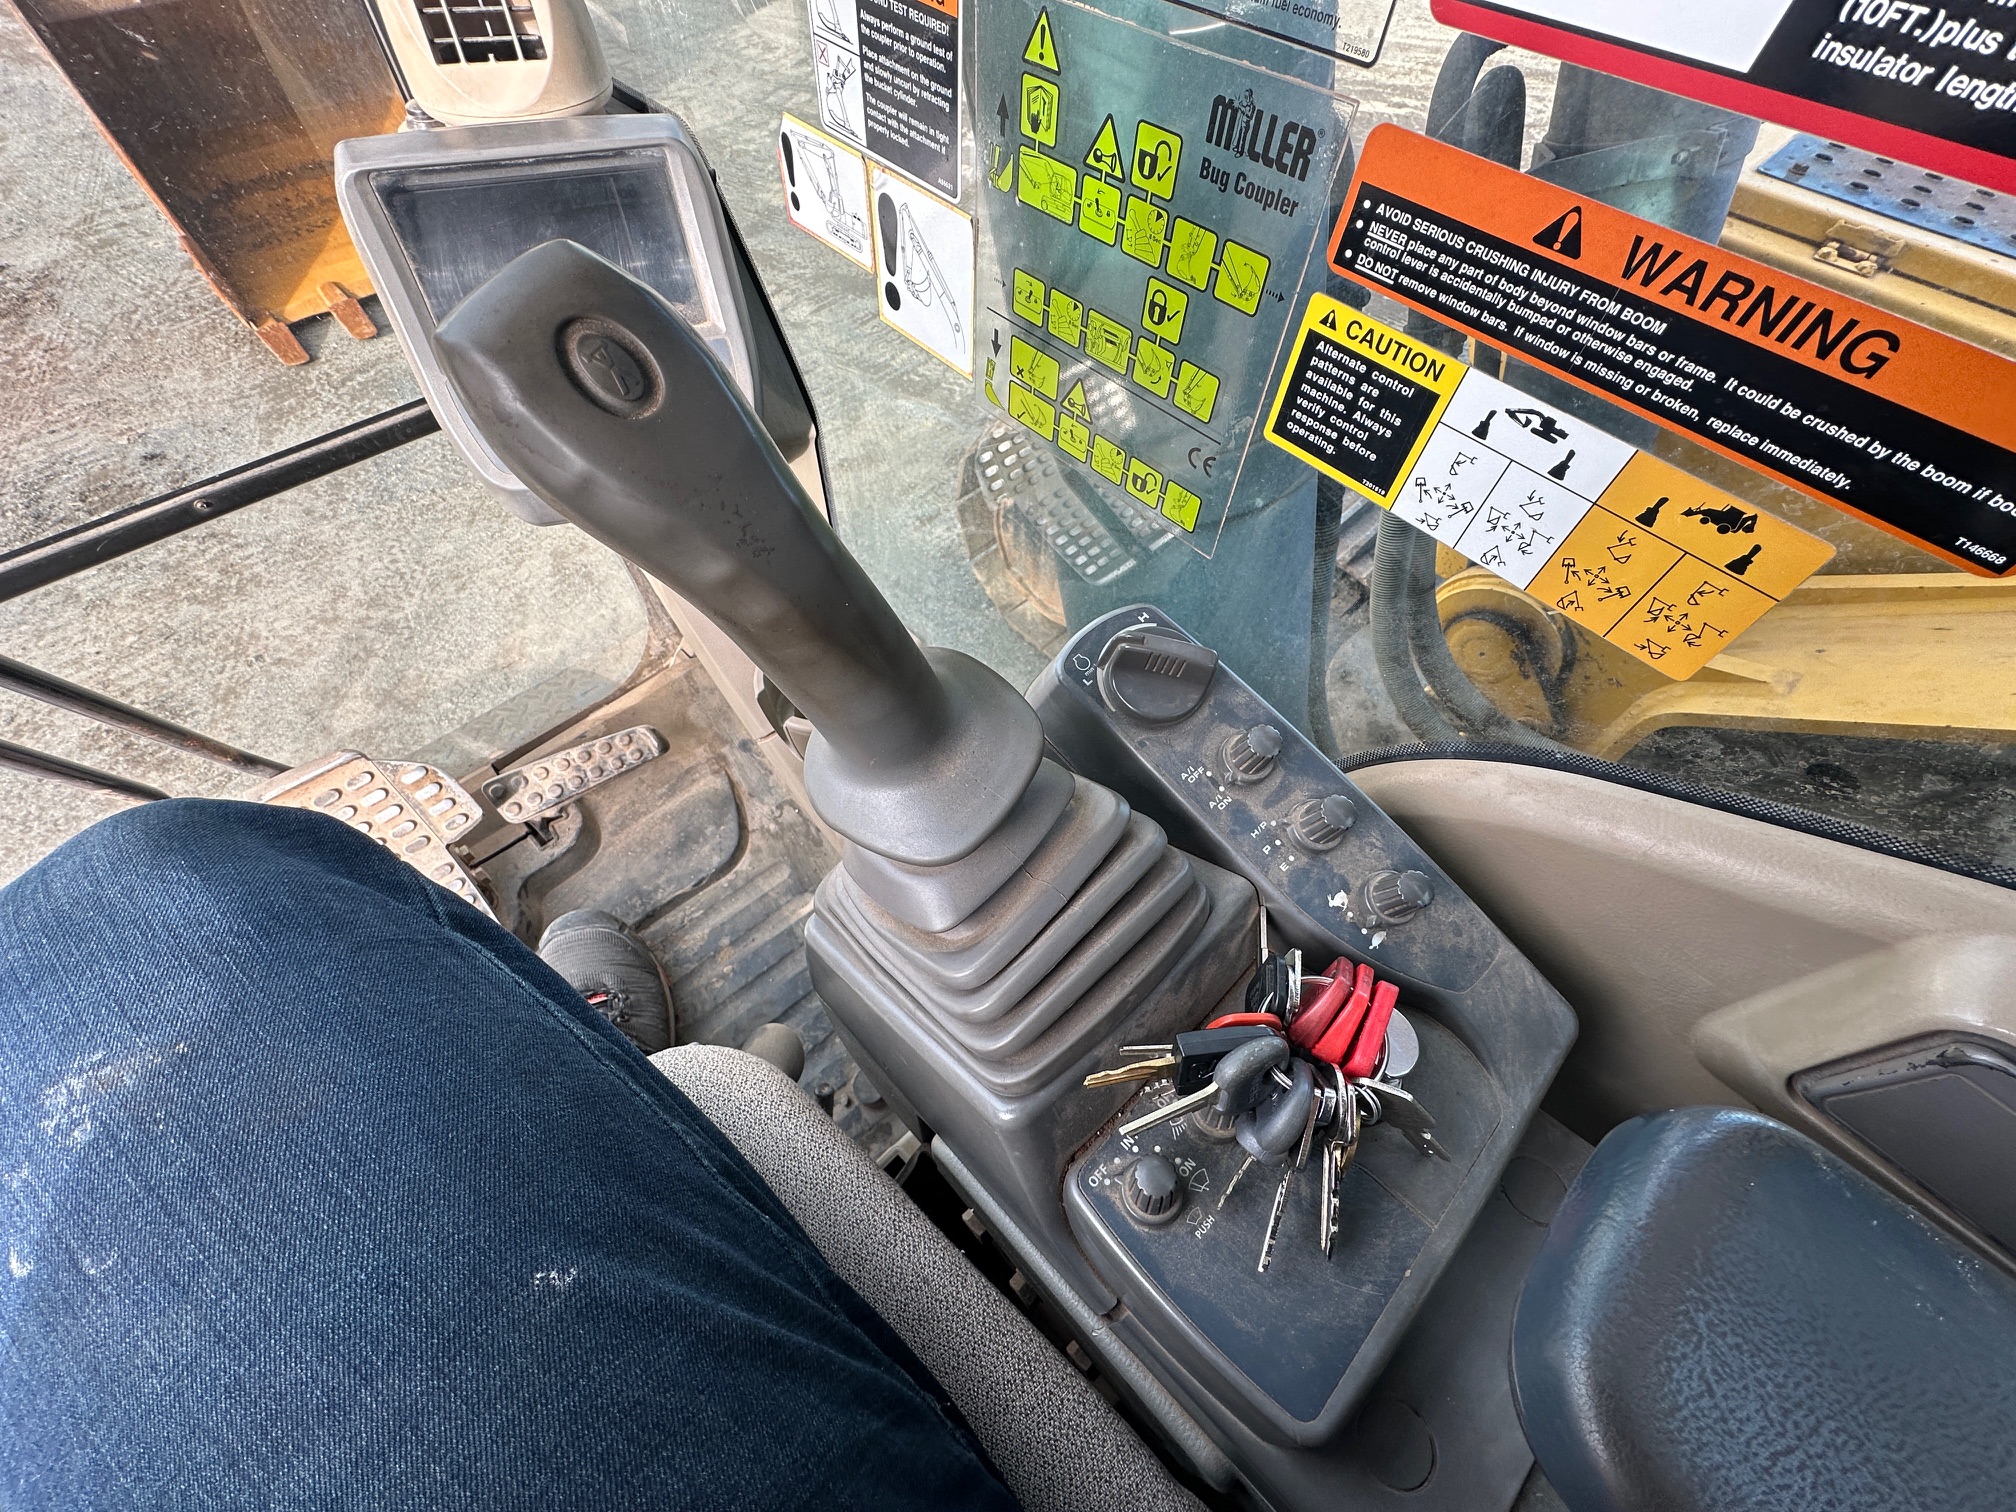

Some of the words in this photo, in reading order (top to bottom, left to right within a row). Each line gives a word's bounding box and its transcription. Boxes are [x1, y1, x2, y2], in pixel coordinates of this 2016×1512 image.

[860, 8, 880, 28] Always
[881, 20, 904, 38] perform
[910, 34, 932, 52] ground
[933, 43, 946, 56] test
[946, 50, 953, 60] of
[890, 0, 907, 17] TEST
[909, 8, 949, 36] REQUIRED!
[1292, 3, 1341, 30] economy.
[860, 24, 870, 36] the
[870, 30, 892, 46] coupler
[893, 41, 907, 54] prior
[908, 46, 915, 58] to
[916, 52, 946, 74] operation.
[1811, 32, 1935, 86] insulator
[862, 44, 878, 60] Place
[878, 54, 910, 77] attachment
[910, 71, 918, 81] on
[920, 73, 930, 86] the
[930, 80, 952, 98] ground
[864, 72, 873, 84] the
[864, 60, 874, 72] and
[912, 83, 920, 97] by
[921, 90, 950, 112] retracting
[866, 92, 876, 106] The
[876, 99, 897, 116] coupler
[898, 110, 908, 122] will
[908, 116, 928, 133] remain
[868, 118, 889, 138] properly
[887, 116, 899, 130] with
[900, 123, 908, 135] the
[1199, 156, 1231, 193] Bug
[1234, 171, 1299, 217] Coupler
[1375, 203, 1412, 226] AVOID
[1412, 218, 1465, 249] SERIOUS
[1465, 241, 1530, 277] CRUSHING
[1530, 268, 1581, 297] INJURY
[1578, 289, 1622, 316] FROM
[1620, 307, 1668, 335] BOOM
[1364, 234, 1402, 260] control
[1401, 252, 1428, 272] lever
[1428, 264, 1440, 278] is
[1440, 272, 1507, 309] accidentally
[1506, 299, 1557, 330] bumped
[1556, 324, 1572, 336] or
[1571, 331, 1633, 364] otherwise
[1634, 359, 1694, 392] engaged.
[1621, 234, 1900, 380] WARNING
[1316, 340, 1367, 373] Alternate
[1371, 371, 1415, 398] control
[1346, 320, 1446, 383] CAUTION
[1368, 221, 1408, 245] NEVER
[1406, 240, 1437, 259] place
[1437, 254, 1460, 271] any
[1458, 263, 1484, 280] part
[1484, 274, 1500, 286] of
[1498, 277, 1529, 301] body
[1529, 291, 1576, 320] beyond
[1576, 314, 1626, 342] window
[1625, 334, 1657, 356] bars
[1657, 350, 1675, 363] or
[1674, 356, 1716, 384] frame.
[1723, 377, 1738, 392] It
[1737, 386, 1783, 410] could
[1780, 402, 1802, 419] be
[1802, 414, 1871, 448] crushed
[1867, 440, 1892, 459] by
[1891, 452, 1921, 471] the
[1920, 464, 1973, 494] boom
[1971, 487, 1991, 500] if
[1310, 356, 1356, 385] patterns
[1360, 382, 1380, 397] are
[1357, 253, 1374, 268] DO
[1374, 260, 1399, 280] NOT
[1398, 274, 1437, 298] remove
[1438, 292, 1481, 318] window
[1480, 310, 1508, 332] bars.
[1513, 325, 1525, 338] If
[1524, 332, 1571, 359] window
[1570, 352, 1583, 365] is
[1583, 360, 1635, 391] missing
[1634, 384, 1652, 396] or
[1650, 389, 1699, 422] broken,
[1706, 417, 1759, 446] replace
[1759, 439, 1851, 490] immediately.
[1300, 383, 1347, 414] machine.
[1352, 410, 1392, 438] Always
[1305, 370, 1353, 400] available
[1358, 396, 1376, 411] for
[1379, 408, 1402, 426] this
[1291, 409, 1338, 440] response
[1342, 436, 1377, 461] before
[1297, 396, 1326, 418] verify
[1330, 415, 1369, 441] control
[1286, 421, 1336, 455] operating.
[1955, 536, 2007, 565] T146668
[1137, 611, 1150, 623] H
[1082, 678, 1093, 686] L
[1180, 766, 1195, 780] A/I
[1187, 766, 1205, 784] OFF
[1208, 794, 1222, 810] A/I
[1218, 796, 1232, 810] ON
[1250, 821, 1267, 838] H/P
[1262, 844, 1271, 855] P
[1279, 862, 1290, 872] E
[1088, 1163, 1109, 1188] OFF
[1178, 1157, 1196, 1178] ON
[1194, 1214, 1216, 1240] PUSH
